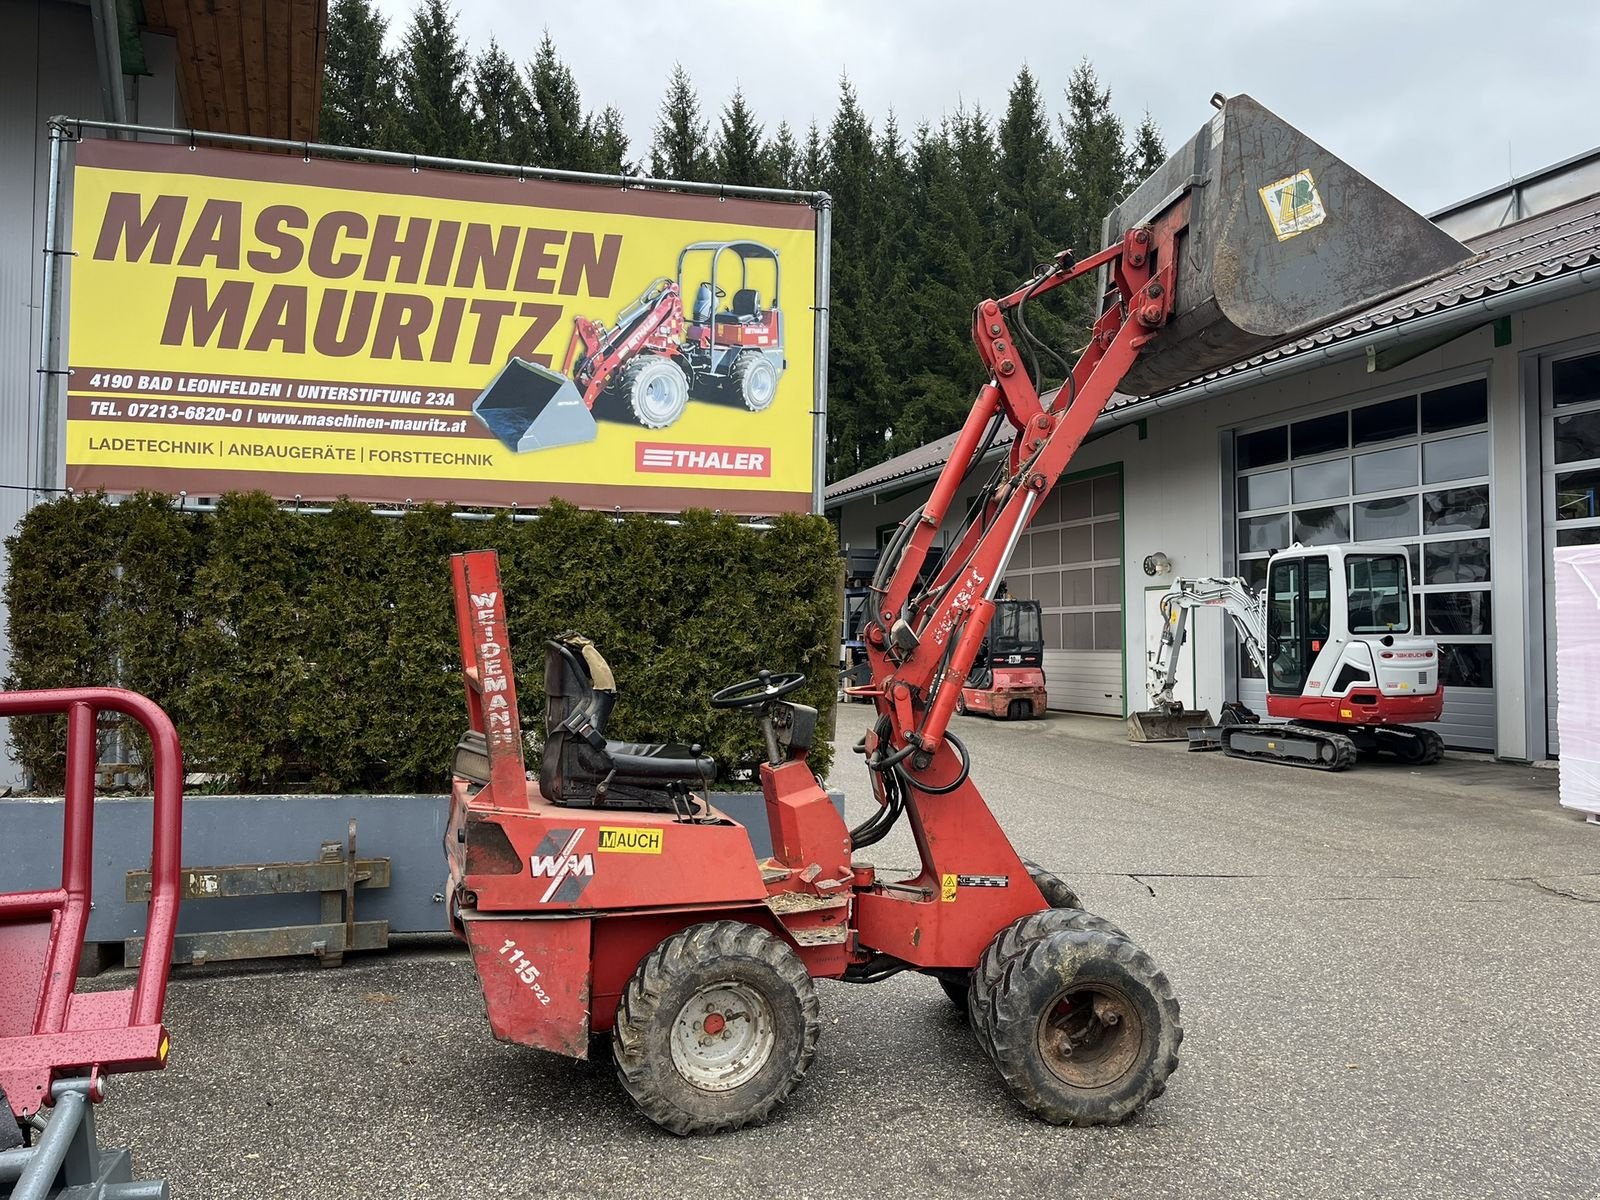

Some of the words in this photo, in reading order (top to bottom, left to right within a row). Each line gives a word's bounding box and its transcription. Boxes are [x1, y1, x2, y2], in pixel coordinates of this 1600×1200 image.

[92, 191, 623, 298] MASCHINEN
[160, 276, 564, 367] MAURITZ
[90, 374, 133, 389] 4190
[138, 375, 173, 391] BAD
[177, 378, 282, 398] LEONFELDEN
[297, 385, 421, 405] UNTERSTIFTUNG
[425, 392, 455, 406] 23A
[90, 401, 122, 417] TEL.
[128, 403, 242, 422] 07213-6820-0
[257, 412, 467, 433] www.maschinen-mauritz.at
[89, 437, 214, 455] LADETECHNIK
[228, 443, 356, 461] ANBAUGERÄTE
[369, 449, 493, 466] FORSTTECHNIK
[674, 450, 764, 470] THALER
[599, 831, 660, 849] MAUCH
[499, 939, 541, 984] 1115
